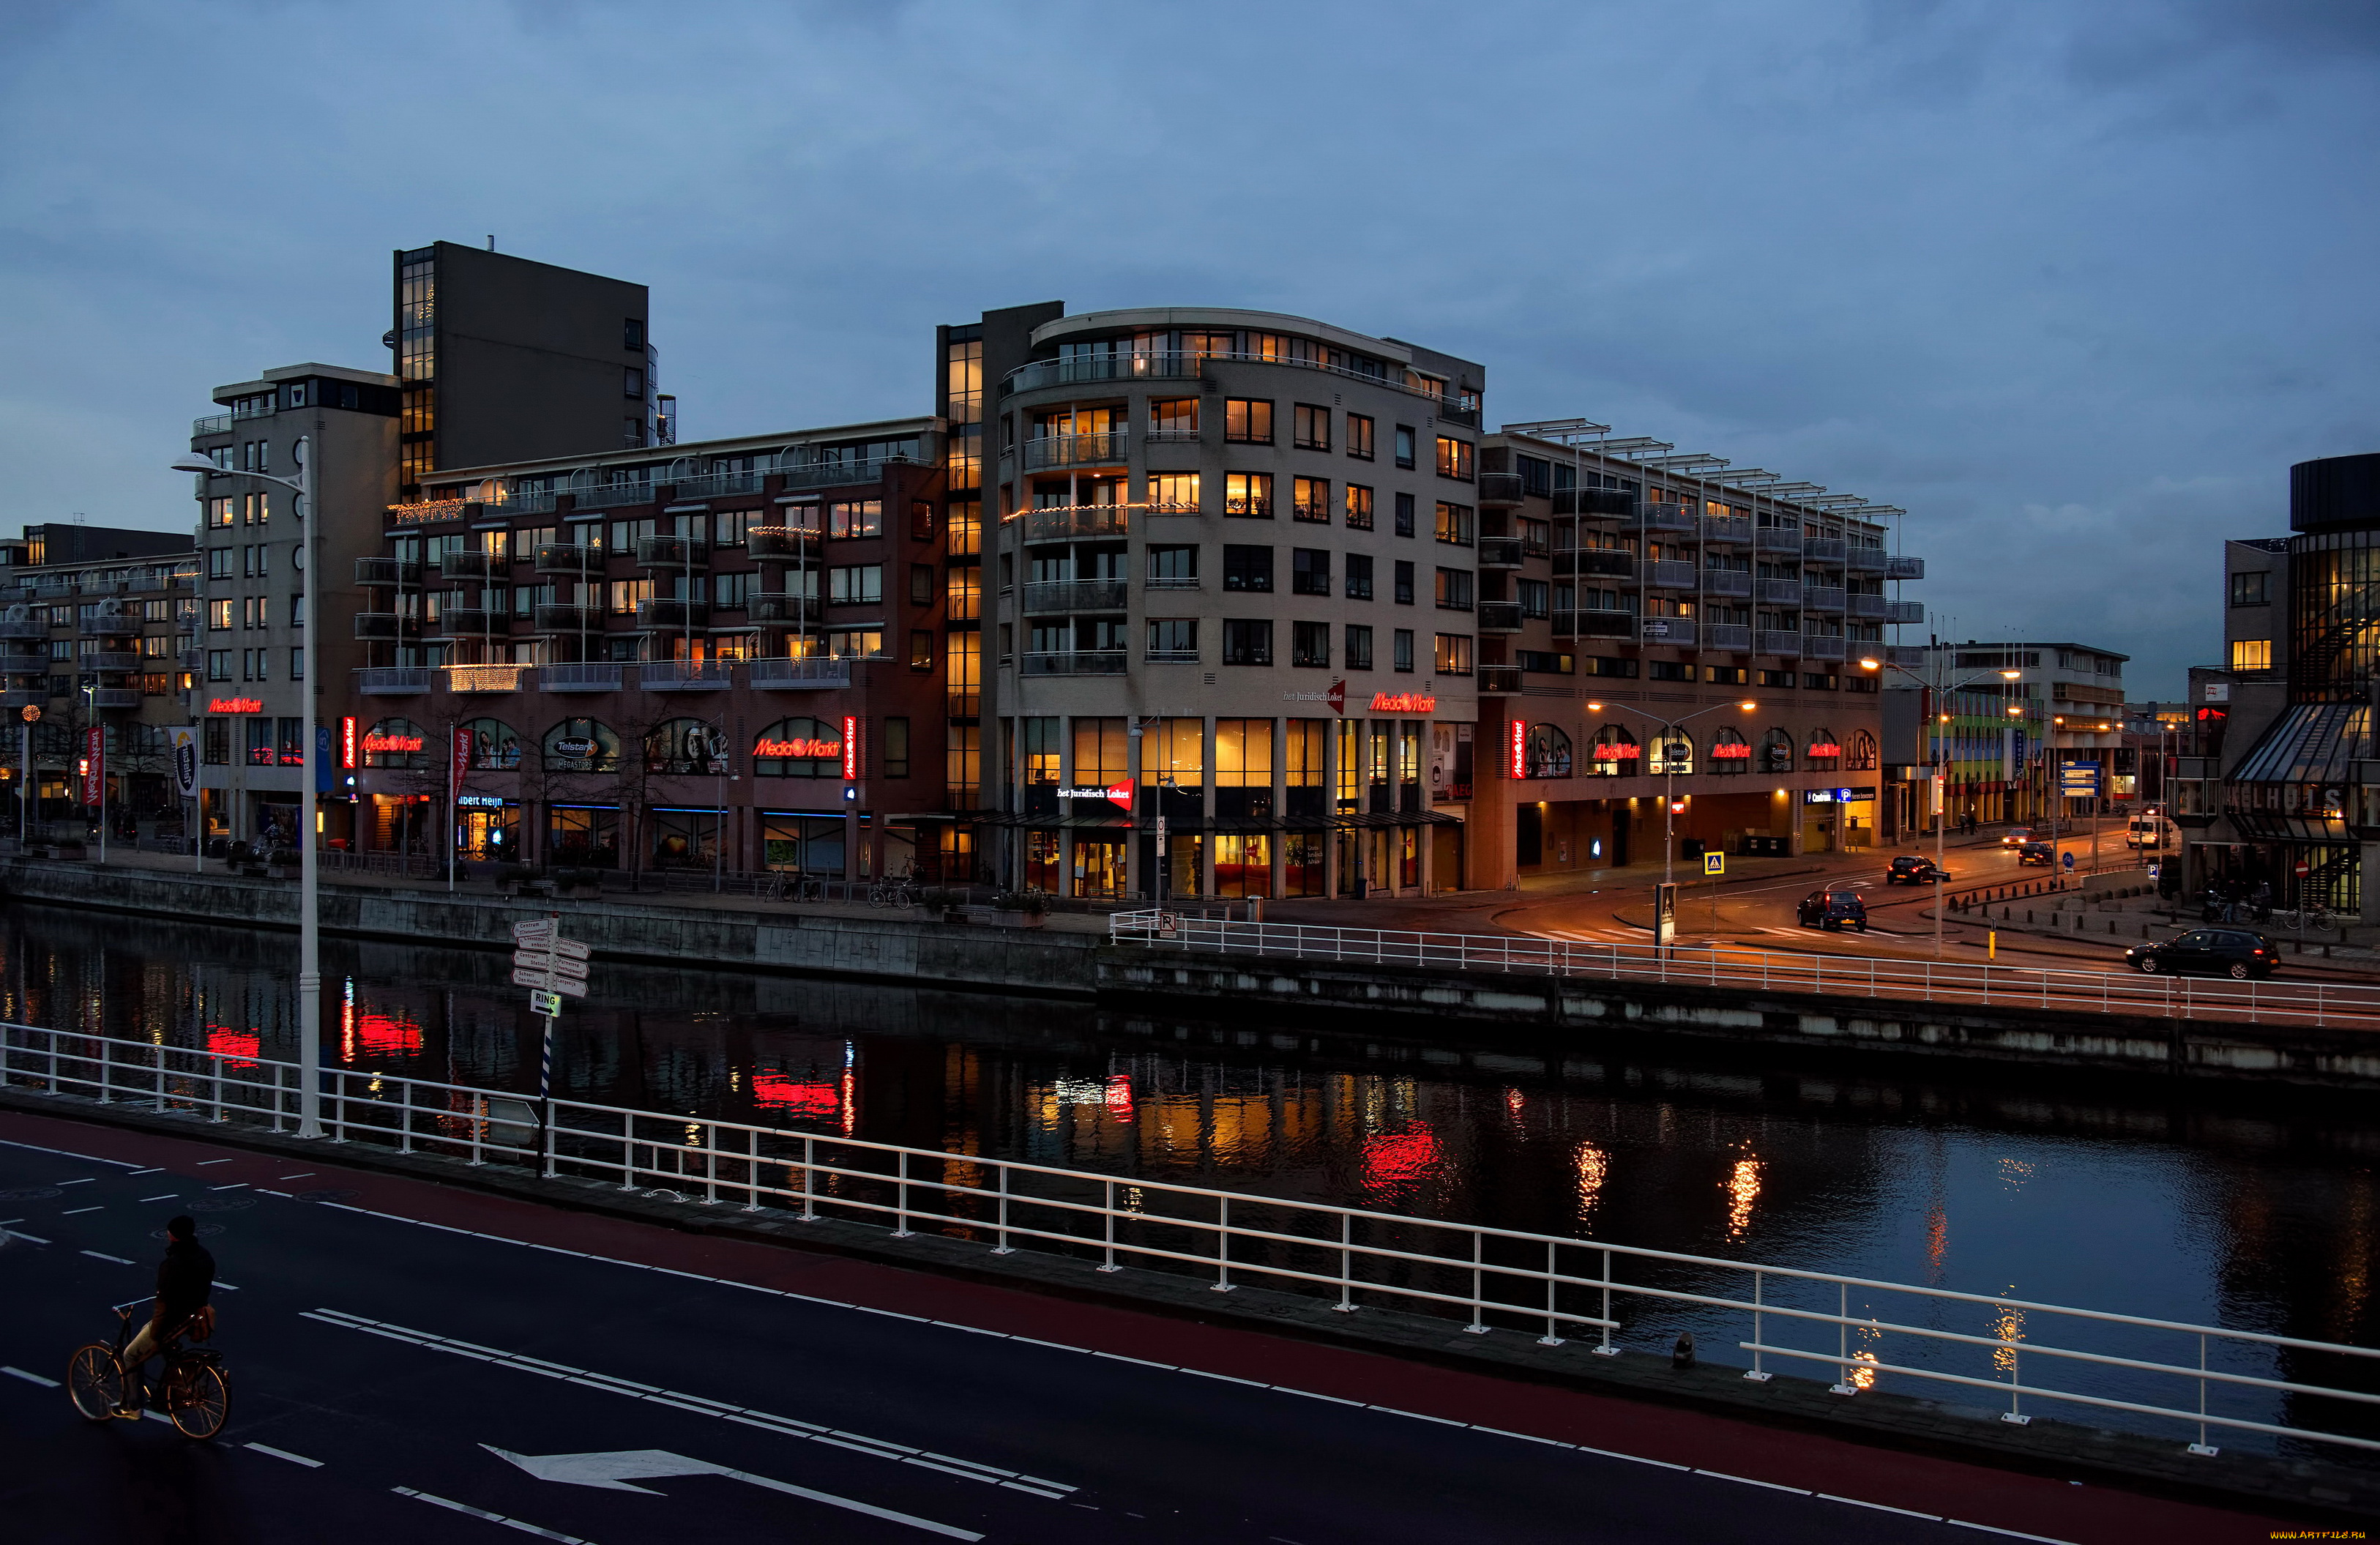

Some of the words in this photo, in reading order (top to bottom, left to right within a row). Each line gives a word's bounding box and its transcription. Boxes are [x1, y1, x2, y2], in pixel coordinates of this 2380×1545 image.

[1283, 691, 1294, 701] het
[1297, 692, 1326, 701] Juridisch
[1327, 692, 1342, 701] Loket
[559, 742, 587, 751] Telstar
[559, 761, 592, 769] MEGASTORE
[1056, 789, 1070, 797] het
[1070, 789, 1105, 799] Juridisch
[1105, 789, 1130, 799] Loket
[1453, 783, 1471, 796] AEG
[536, 993, 556, 1005] RING
